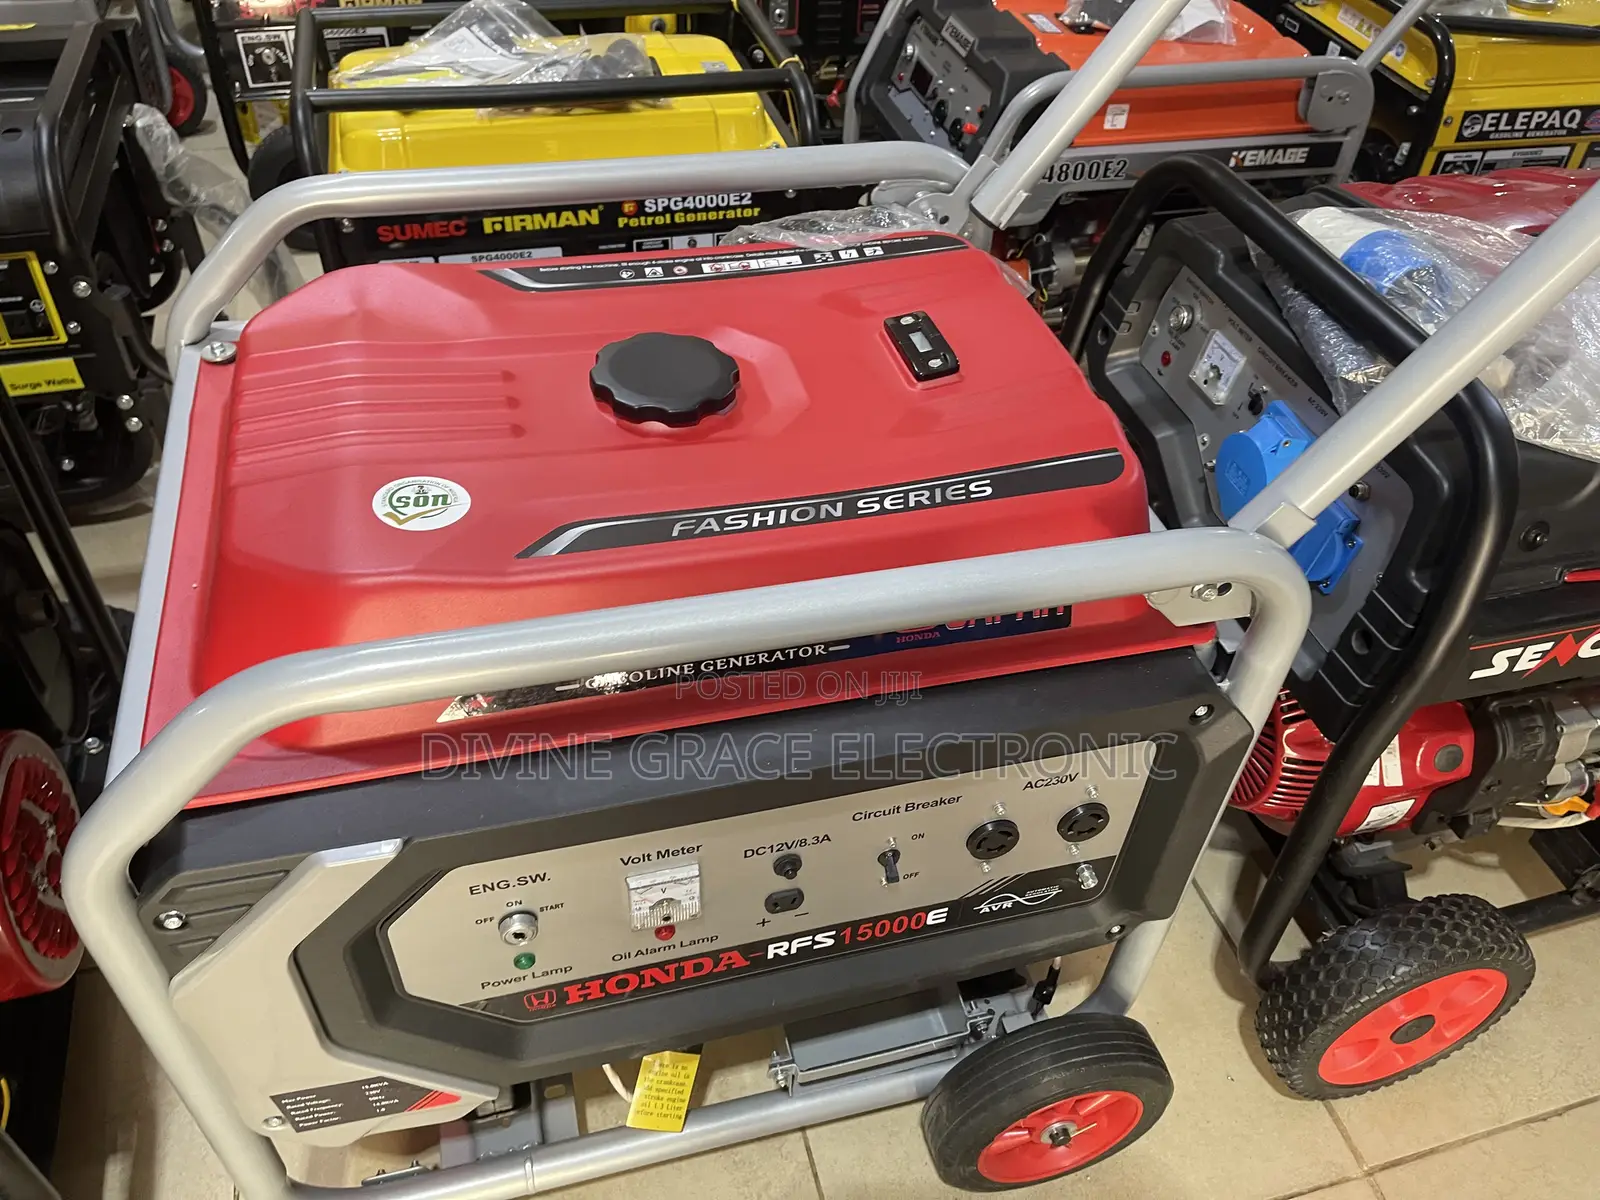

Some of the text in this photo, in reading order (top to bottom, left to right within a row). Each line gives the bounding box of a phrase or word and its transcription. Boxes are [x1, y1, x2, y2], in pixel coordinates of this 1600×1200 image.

[1482, 109, 1582, 132] ELEPAQ
[1229, 147, 1310, 168] KEMAGE
[644, 192, 752, 213] SPG4000E2
[376, 208, 600, 243] SUMEC FIRMAN
[618, 207, 761, 228] Petrol Generator
[471, 250, 533, 264] SPG4000E2
[671, 479, 993, 537] FASHION SERIES
[896, 631, 941, 644] HONDA
[585, 644, 827, 690] GOLINE GENERATOR
[1022, 772, 1079, 791] AC230V
[852, 795, 963, 823] Circuit Breaker
[743, 833, 832, 859] DC12V/8.3A
[911, 831, 925, 841] ON
[620, 844, 703, 867] Volt Meter
[468, 871, 551, 896] ENG.SW.
[903, 871, 920, 880] OFF
[506, 900, 523, 908] ON
[539, 902, 565, 913] START
[979, 902, 1013, 914] AVR
[475, 916, 495, 925] OFF
[611, 934, 719, 963] Oil Alarm Lamp
[480, 964, 573, 990] Power Lamp
[564, 950, 750, 1005] HONDA
